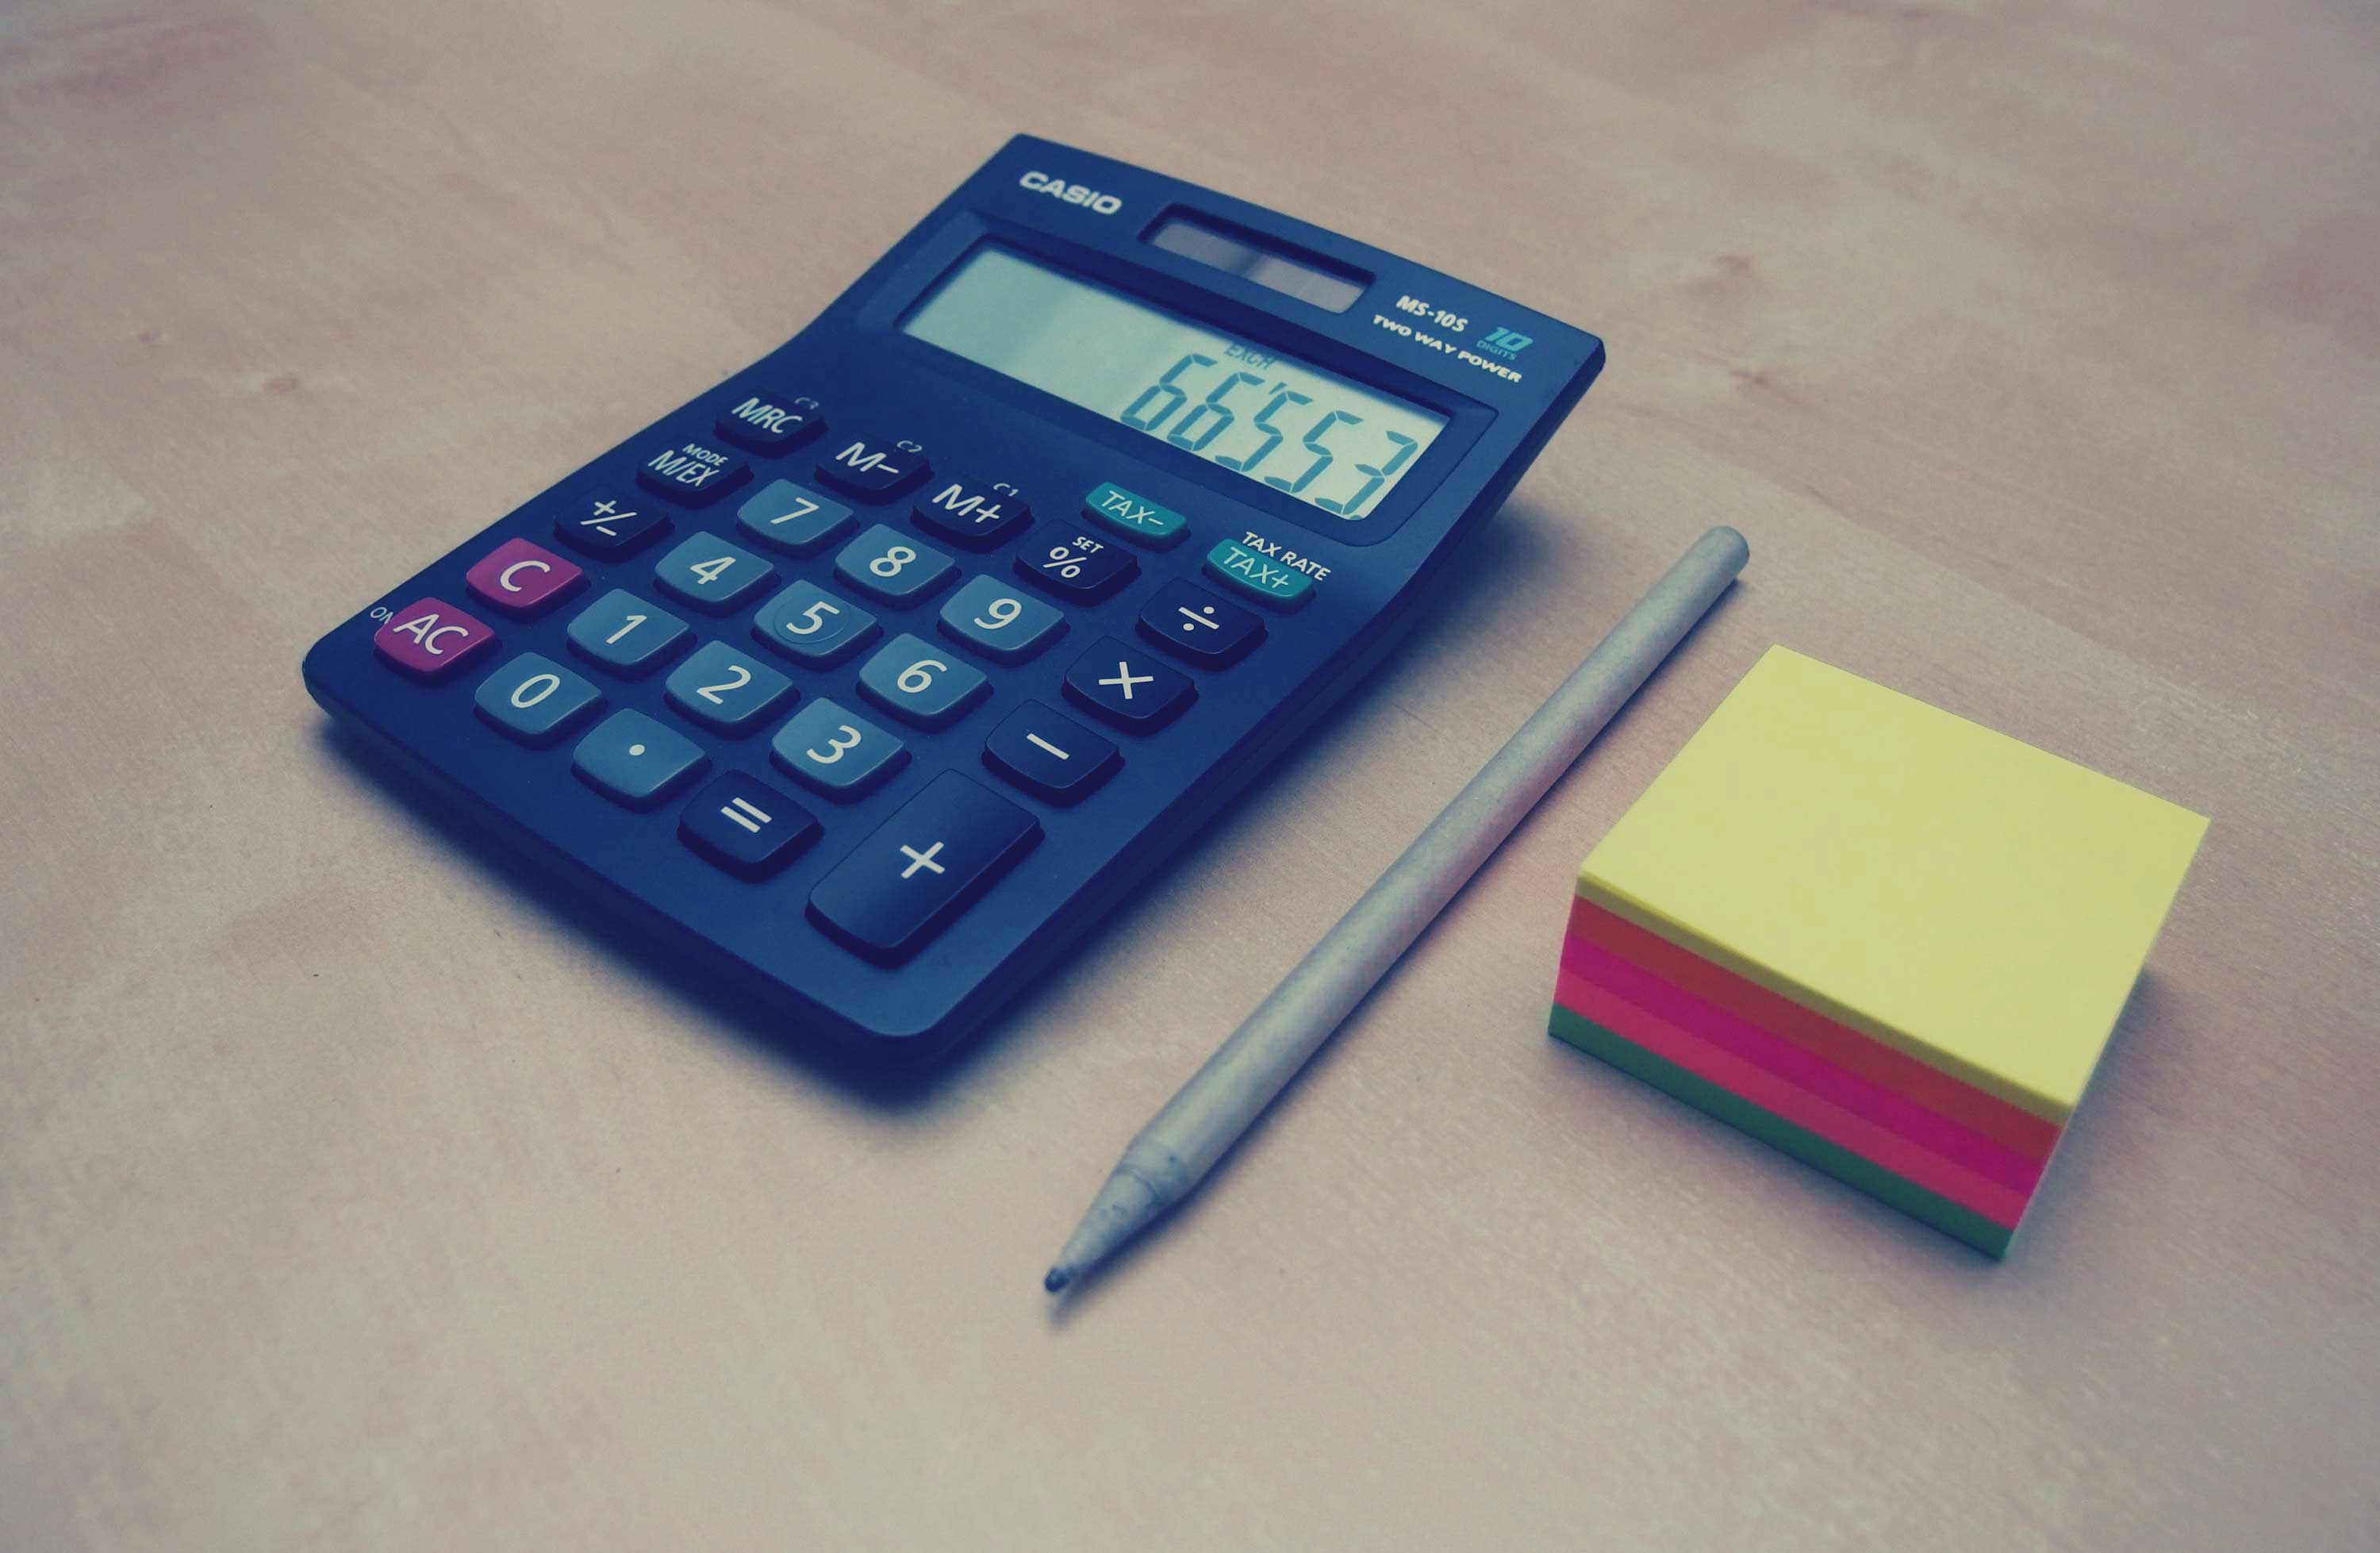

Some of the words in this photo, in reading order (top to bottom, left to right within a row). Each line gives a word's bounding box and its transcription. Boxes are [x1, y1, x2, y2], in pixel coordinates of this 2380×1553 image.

[1019, 171, 1122, 214] CASIO
[1396, 295, 1468, 332] MS-10S
[1373, 314, 1412, 336] TWO
[1415, 332, 1457, 354] WAY
[1457, 351, 1522, 382] POWER
[1476, 340, 1518, 360] DIGITS
[1485, 327, 1534, 352] 10
[731, 397, 803, 433] MRC
[647, 450, 720, 486] M/EX
[682, 444, 728, 466] MODE
[770, 497, 820, 525] 7
[932, 483, 1001, 523] M+
[869, 546, 916, 578] 8
[1043, 546, 1087, 579] %
[1073, 536, 1104, 554] SET
[1242, 531, 1281, 557] TAX
[1280, 552, 1331, 581] RATE
[499, 560, 551, 593] C
[689, 556, 736, 585] 4
[1223, 547, 1289, 589] TAX+
[605, 614, 647, 644] 1
[786, 601, 840, 635] 5
[973, 598, 1022, 629] 9
[393, 613, 469, 655] AC
[510, 673, 561, 709] 0
[696, 664, 752, 705] 2
[896, 659, 948, 694] 6
[806, 725, 862, 763] 3
